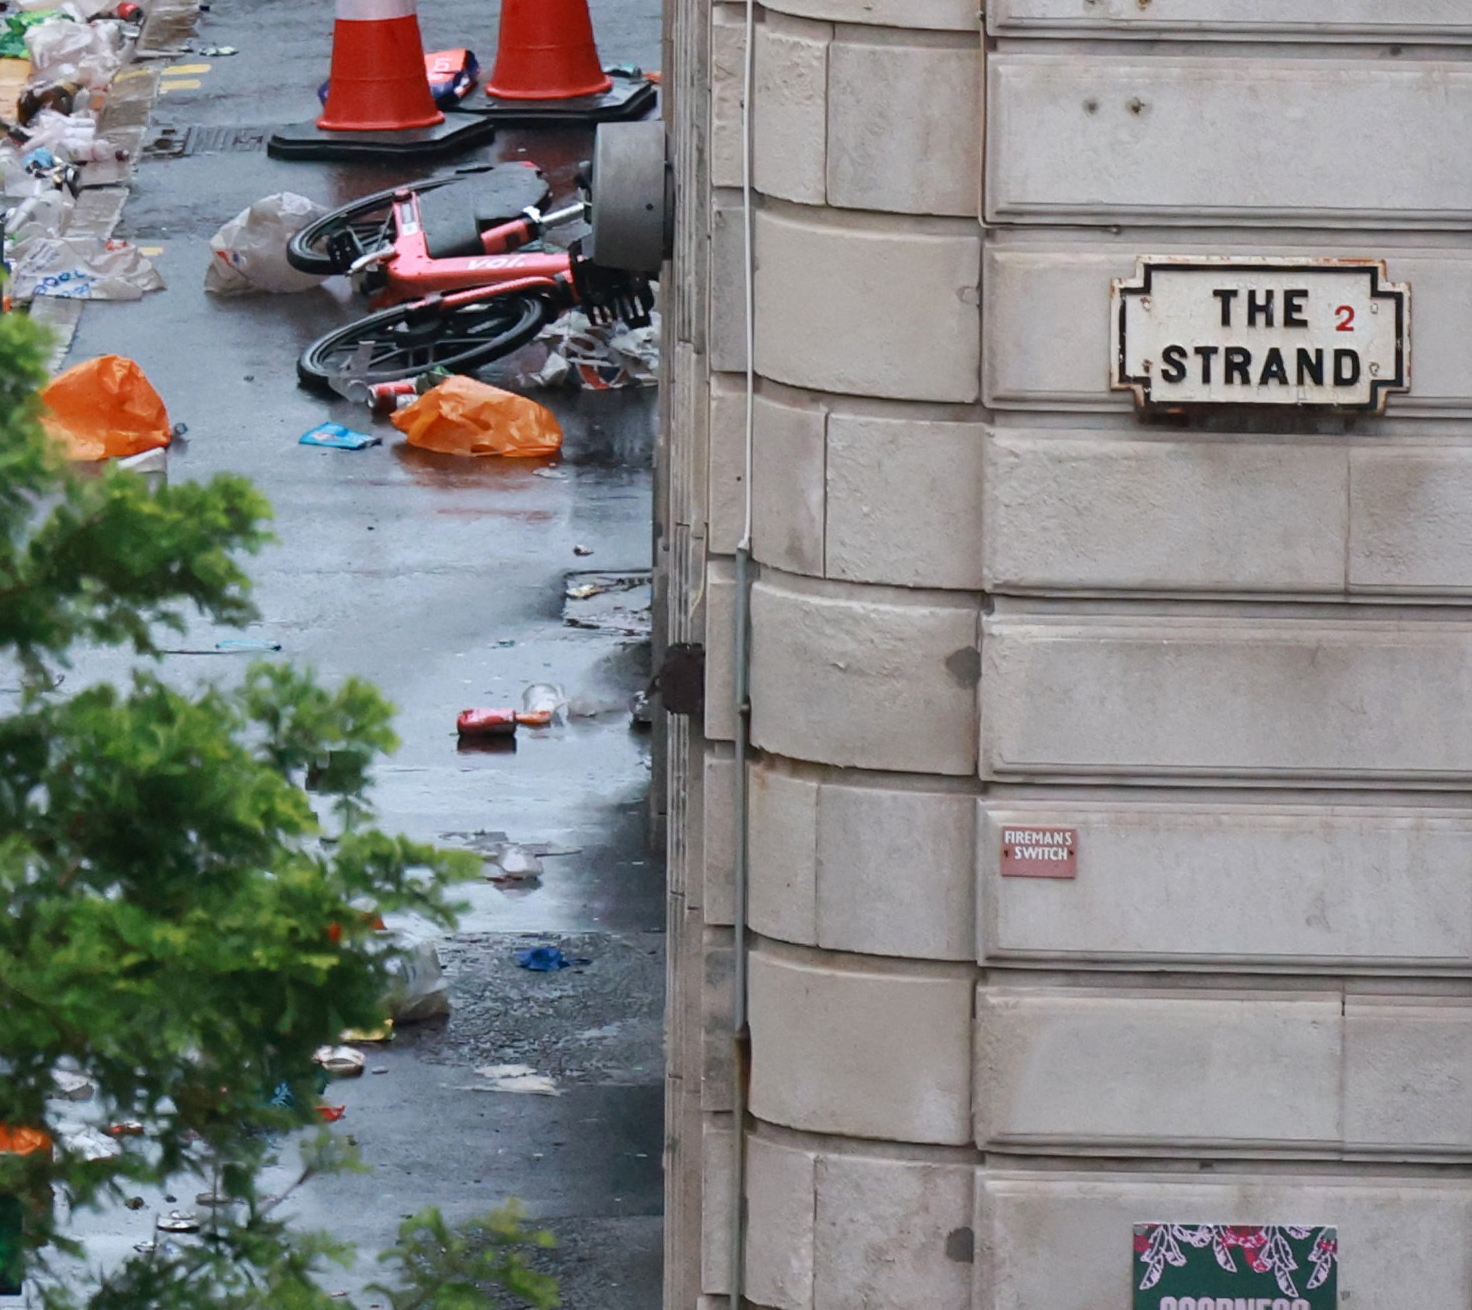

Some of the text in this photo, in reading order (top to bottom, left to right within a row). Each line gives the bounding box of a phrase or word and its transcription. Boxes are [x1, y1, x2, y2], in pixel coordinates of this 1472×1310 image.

[1213, 289, 1355, 331] THE 2
[1161, 345, 1361, 386] STRAND
[1015, 846, 1067, 860] SWITCH
